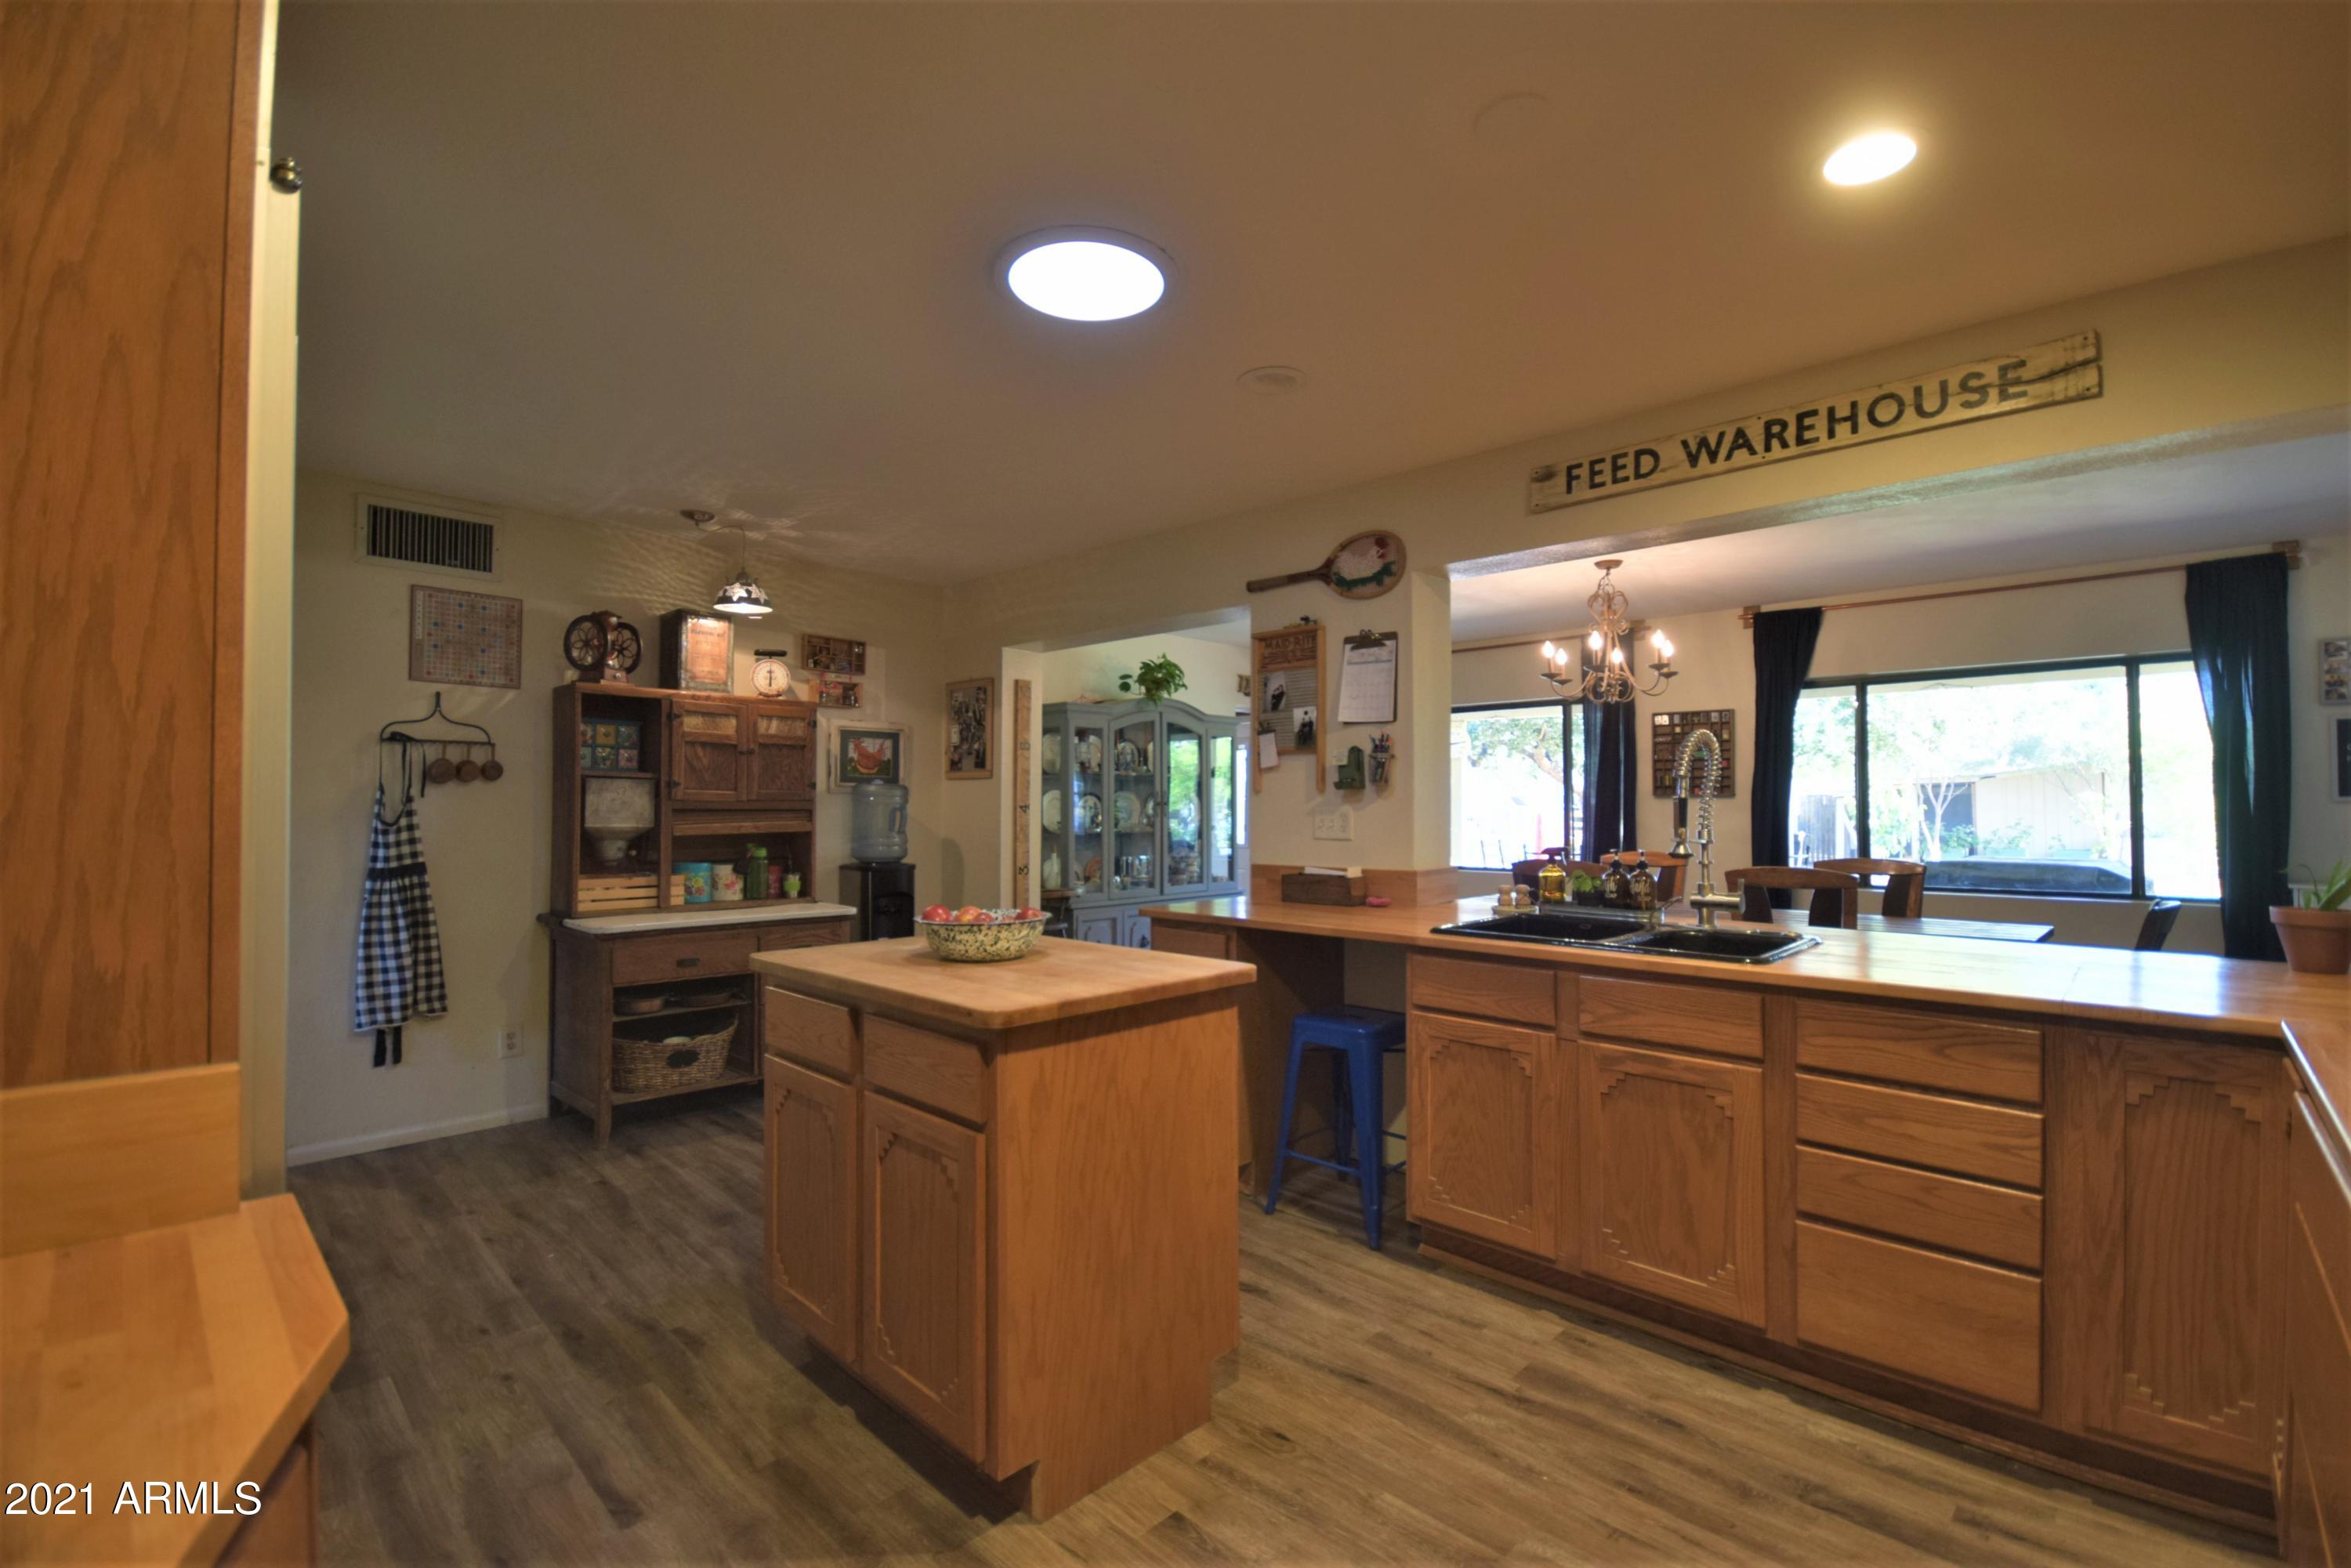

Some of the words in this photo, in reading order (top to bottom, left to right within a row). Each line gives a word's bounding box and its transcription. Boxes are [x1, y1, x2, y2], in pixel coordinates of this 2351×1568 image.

[1565, 447, 1661, 495] FEED
[1680, 358, 2029, 470] WAREHOUSE
[1019, 803, 1030, 814] 4
[1018, 864, 1030, 875] 3
